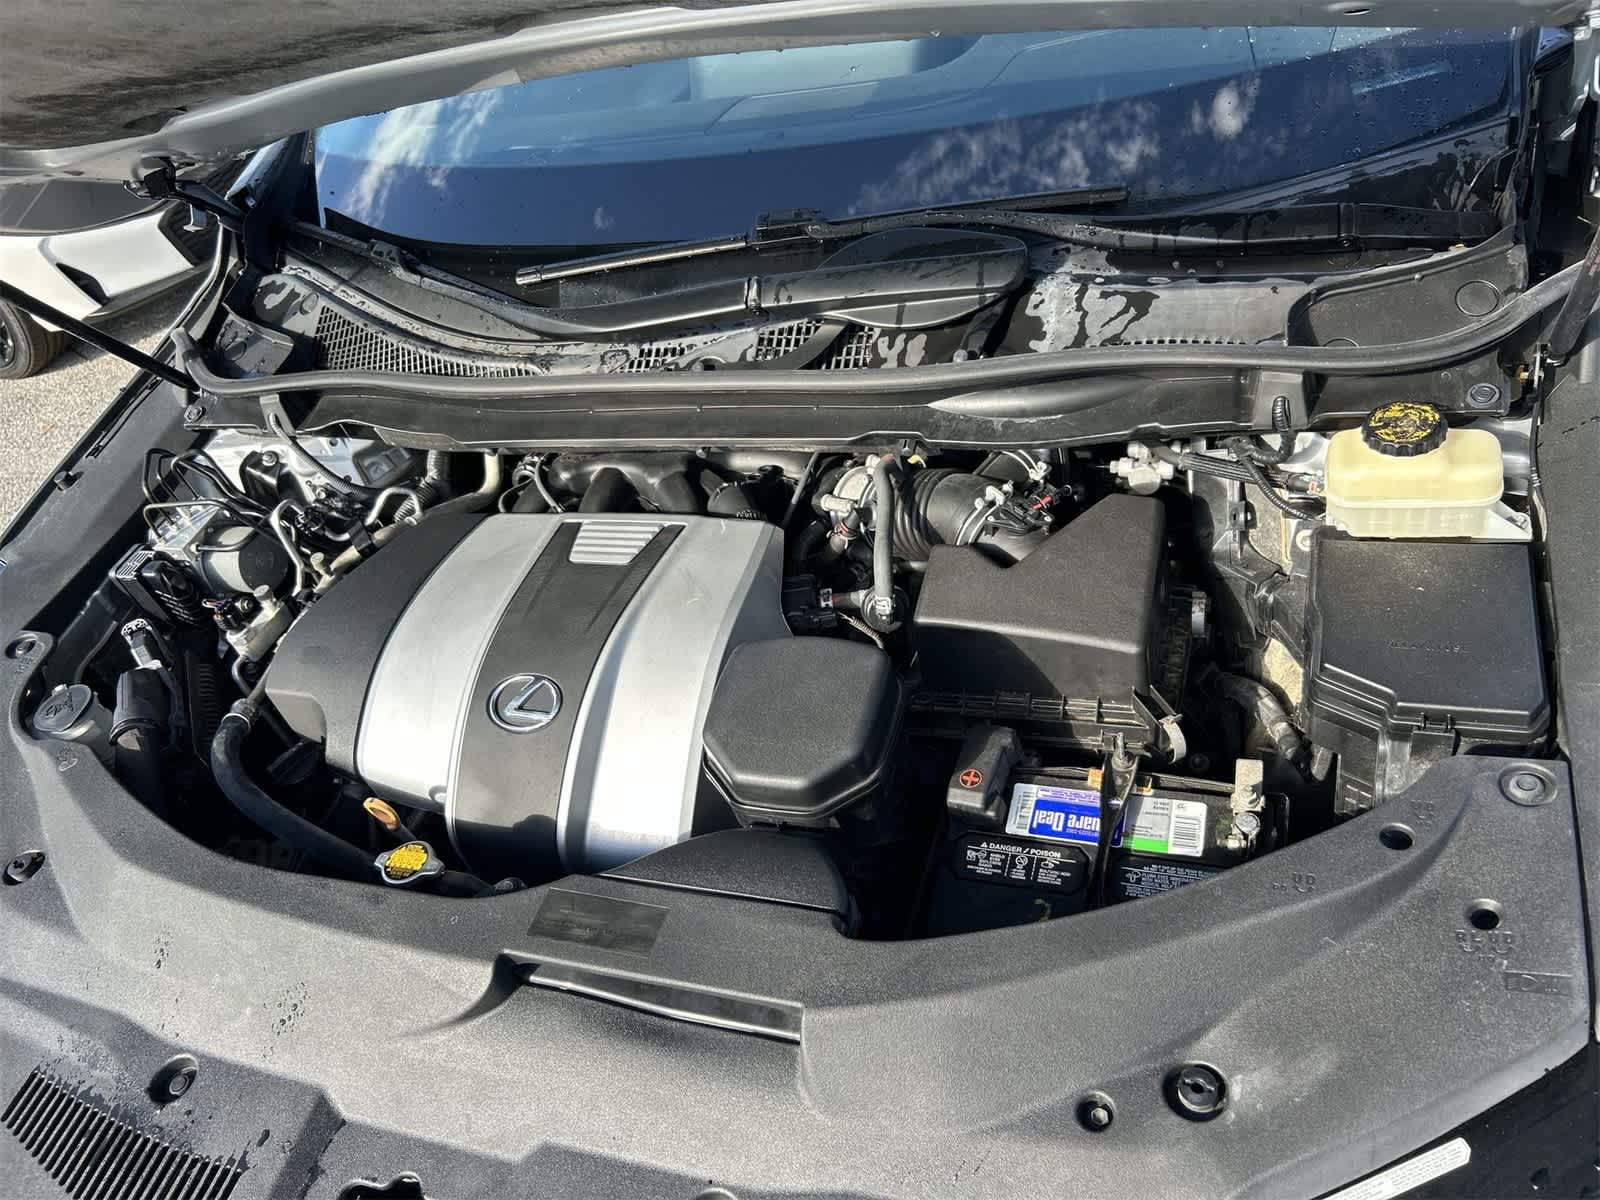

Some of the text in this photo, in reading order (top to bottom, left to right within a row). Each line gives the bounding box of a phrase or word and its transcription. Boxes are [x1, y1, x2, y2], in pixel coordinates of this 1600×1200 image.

[1032, 809, 1066, 833] Deal
[1066, 813, 1101, 832] uare
[988, 842, 1023, 854] DANGER
[1030, 848, 1062, 859] POISON
